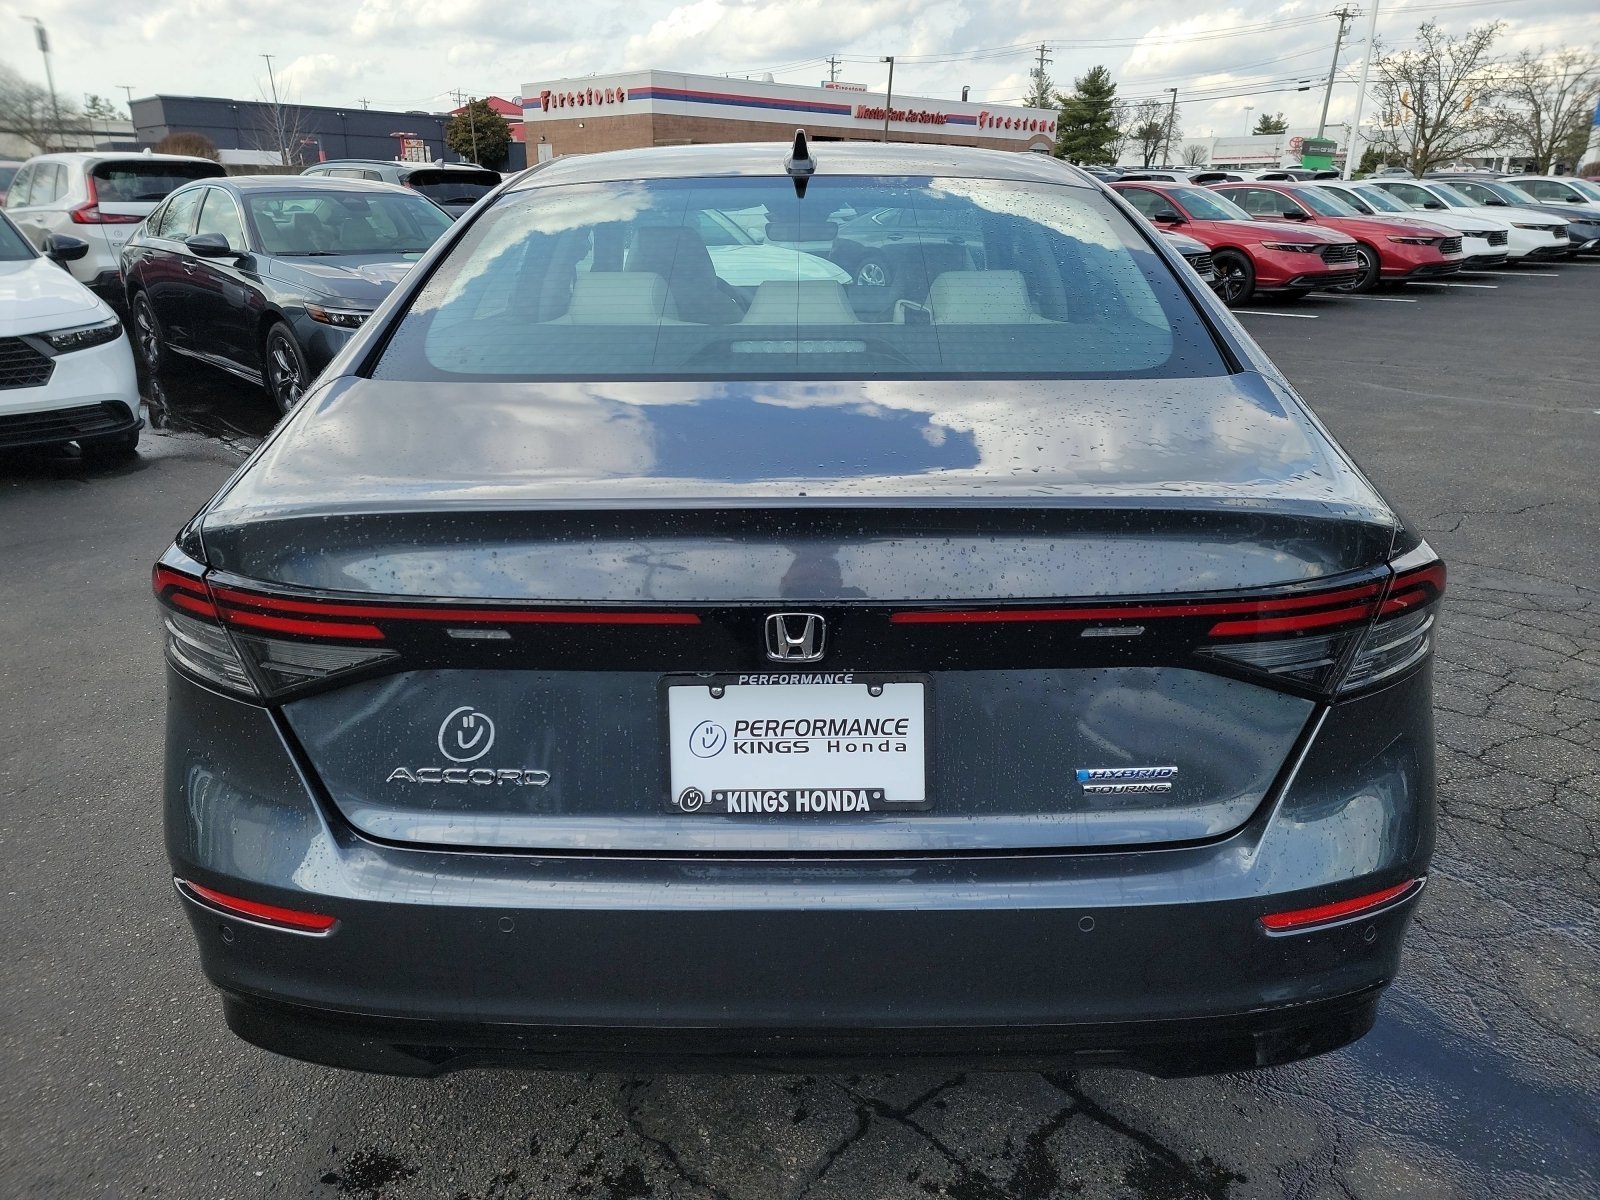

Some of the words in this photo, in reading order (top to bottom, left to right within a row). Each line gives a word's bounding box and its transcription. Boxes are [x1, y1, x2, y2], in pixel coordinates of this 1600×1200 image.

[541, 87, 625, 112] Firestone
[979, 111, 1056, 133] Firestone
[738, 673, 854, 685] PERFORMANCE
[733, 718, 909, 738] PERFORMANCE
[733, 740, 810, 755] KINGS
[827, 740, 907, 753] Honda
[386, 767, 551, 787] ACCORD
[1086, 767, 1177, 780] HYBRID
[1084, 783, 1172, 795] TOURING
[727, 791, 789, 813] KINGS
[795, 790, 870, 812] HONDA
